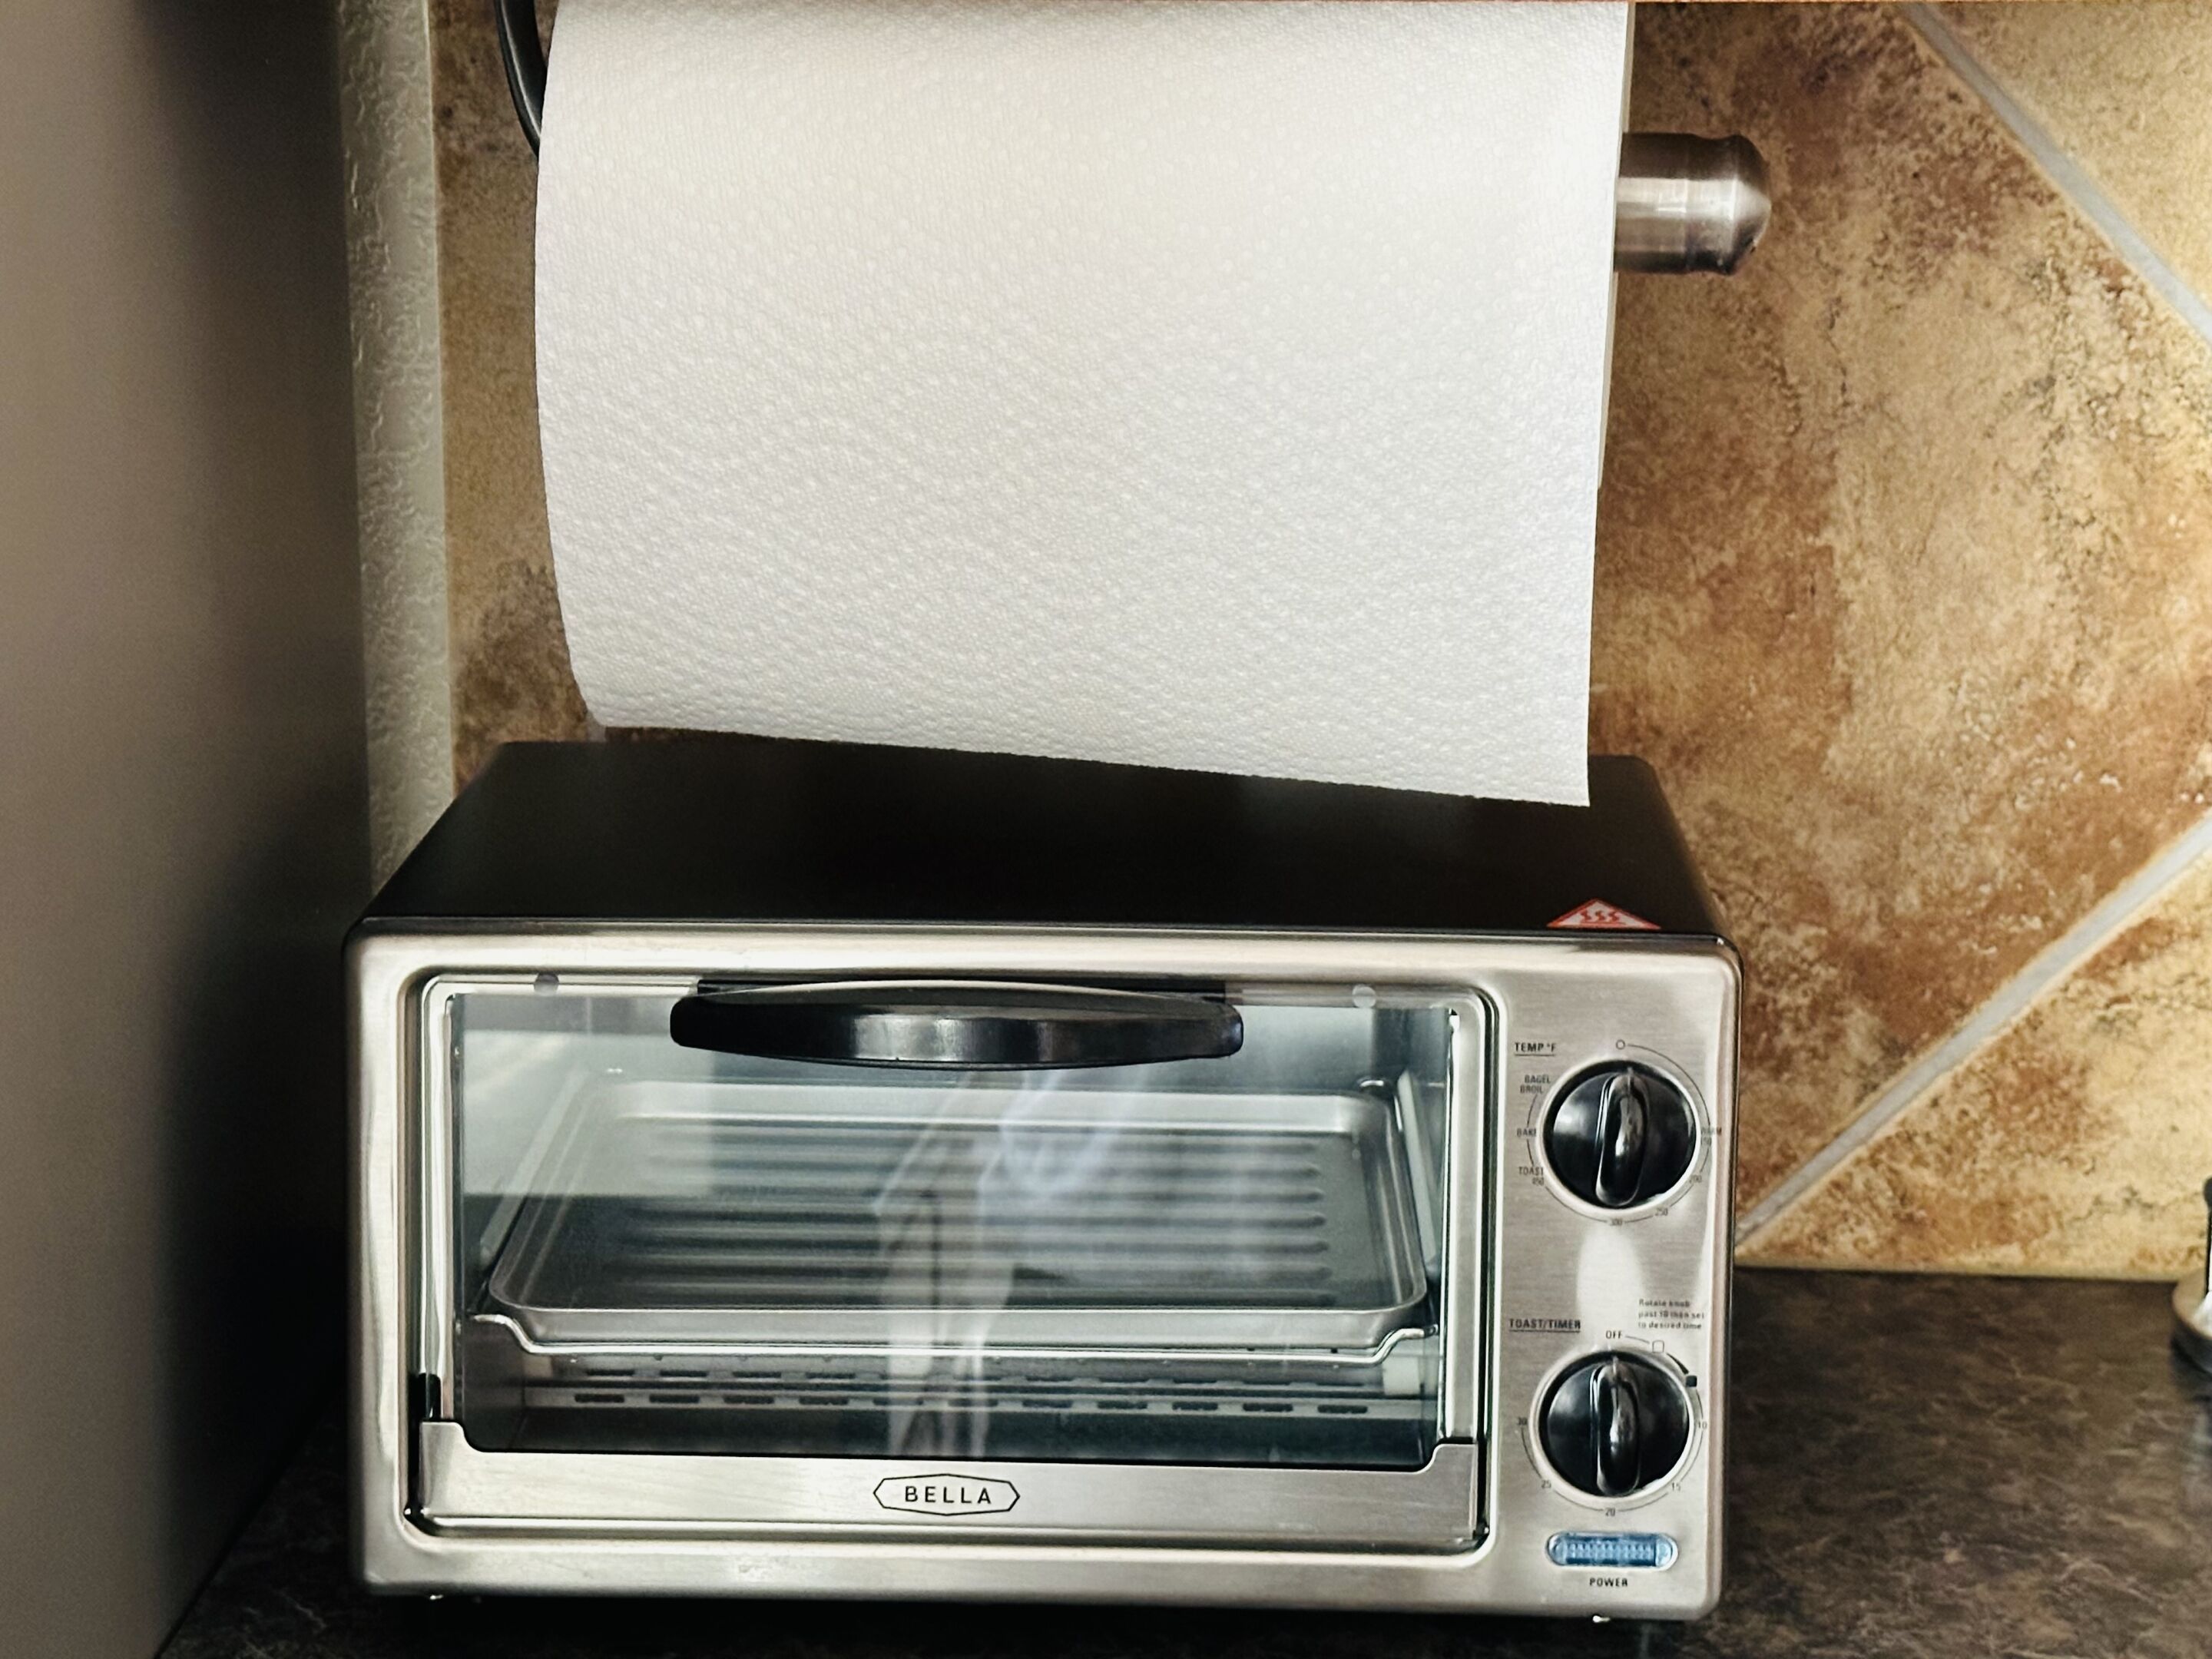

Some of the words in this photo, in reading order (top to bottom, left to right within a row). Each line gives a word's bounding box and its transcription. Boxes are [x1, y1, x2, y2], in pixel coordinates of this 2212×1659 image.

[1515, 1042, 1544, 1052] TEMP
[1525, 1075, 1550, 1084] BAGEL
[1520, 1084, 1542, 1094] BROIL
[1509, 1318, 1581, 1330] TOAST/TIMER
[1605, 1331, 1623, 1340] OFF
[1697, 1421, 1707, 1429] 10
[905, 1485, 992, 1504] BELLA
[1605, 1507, 1616, 1517] 20
[1589, 1577, 1628, 1588] POWER
